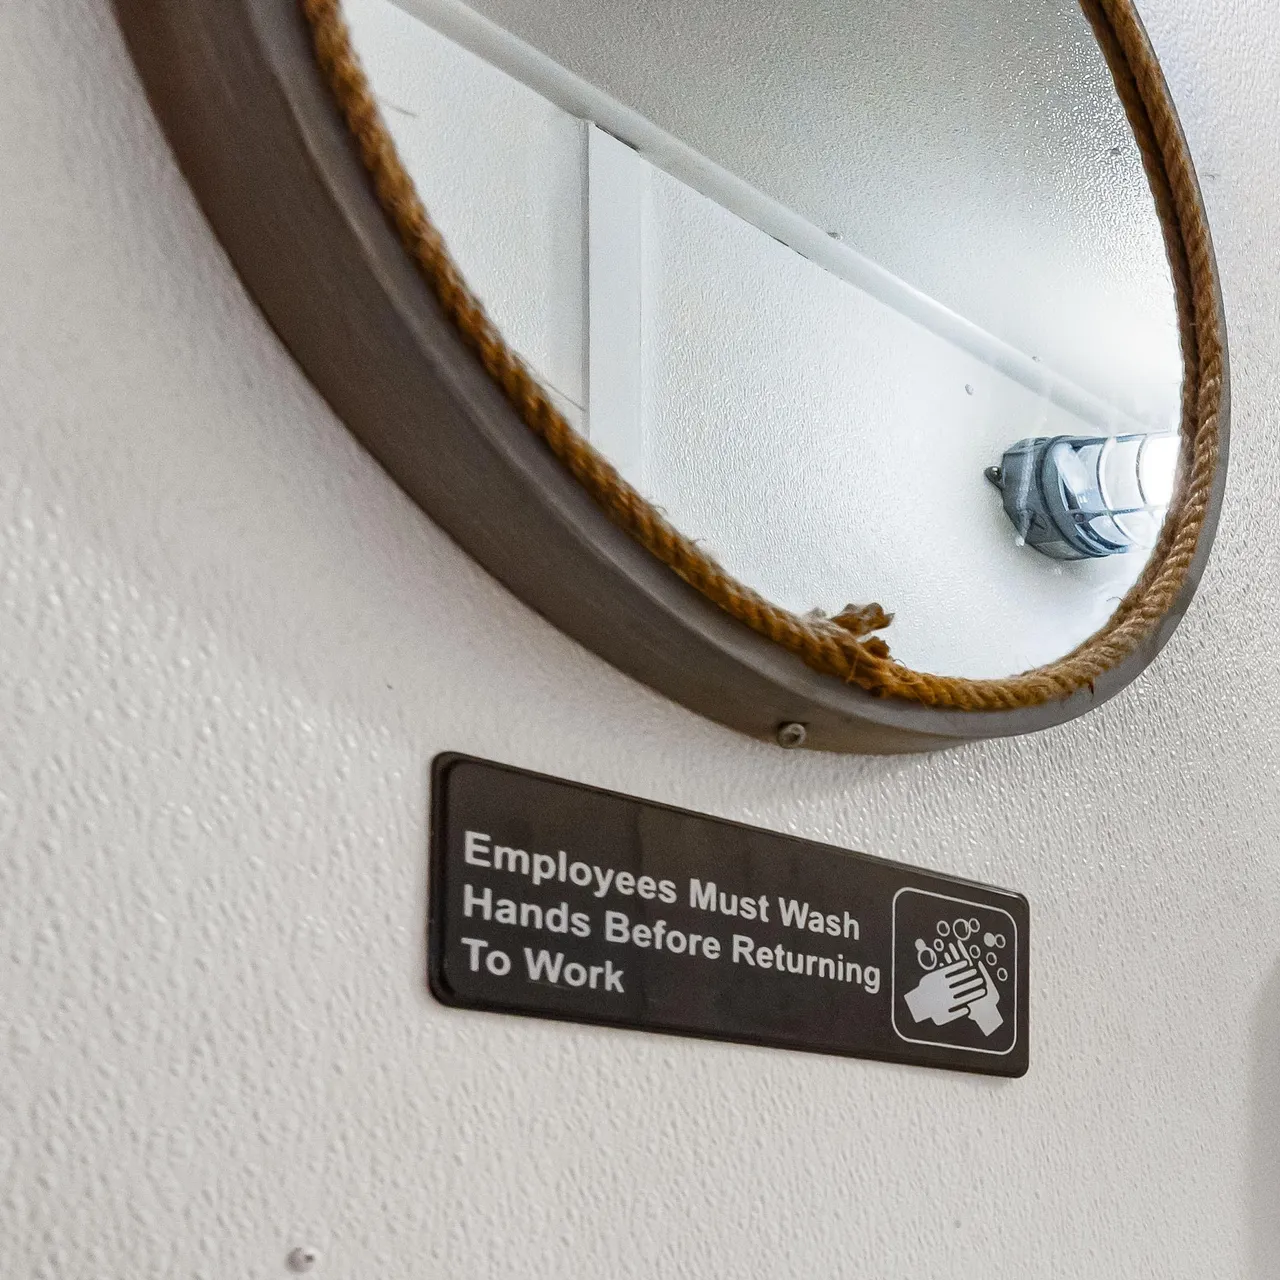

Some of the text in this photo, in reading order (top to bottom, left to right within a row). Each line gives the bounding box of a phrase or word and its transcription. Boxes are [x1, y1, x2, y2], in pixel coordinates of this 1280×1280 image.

[463, 830, 861, 942] Employees Must Wash
[463, 884, 881, 994] Hands Before Returning
[460, 937, 625, 994] To Work
